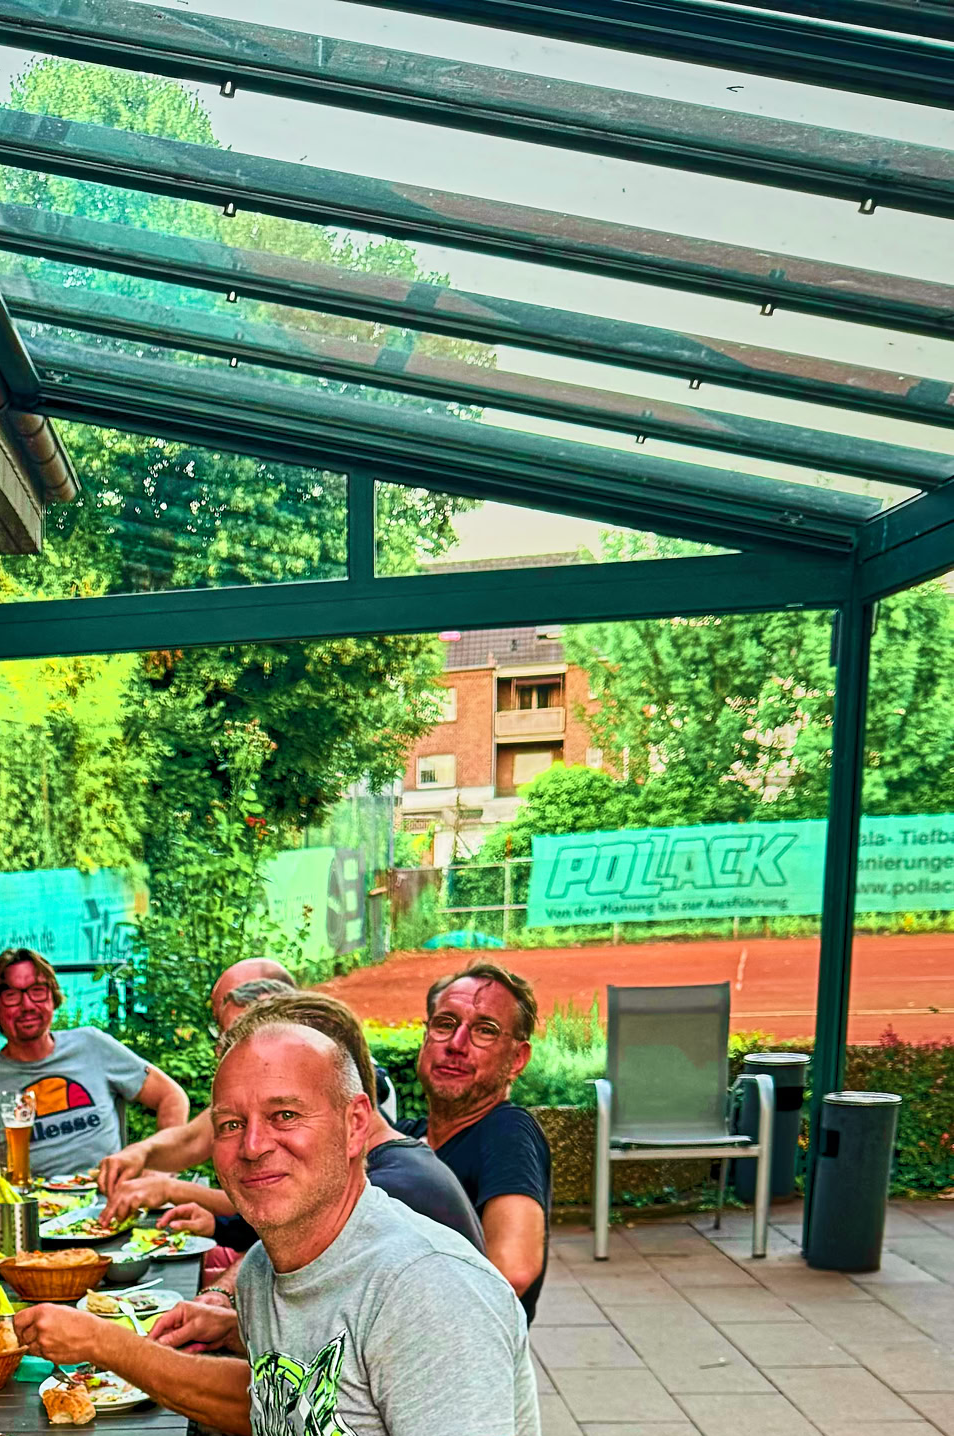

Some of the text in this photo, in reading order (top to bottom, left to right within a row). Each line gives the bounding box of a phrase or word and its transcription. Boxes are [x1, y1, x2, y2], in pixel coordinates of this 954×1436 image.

[544, 833, 799, 899] POLLACK
[858, 854, 954, 873] anierunge
[857, 878, 954, 899] ww.pollac
[545, 896, 788, 919] Von der Planung bis zur Ausführung
[31, 1114, 102, 1143] lesse
